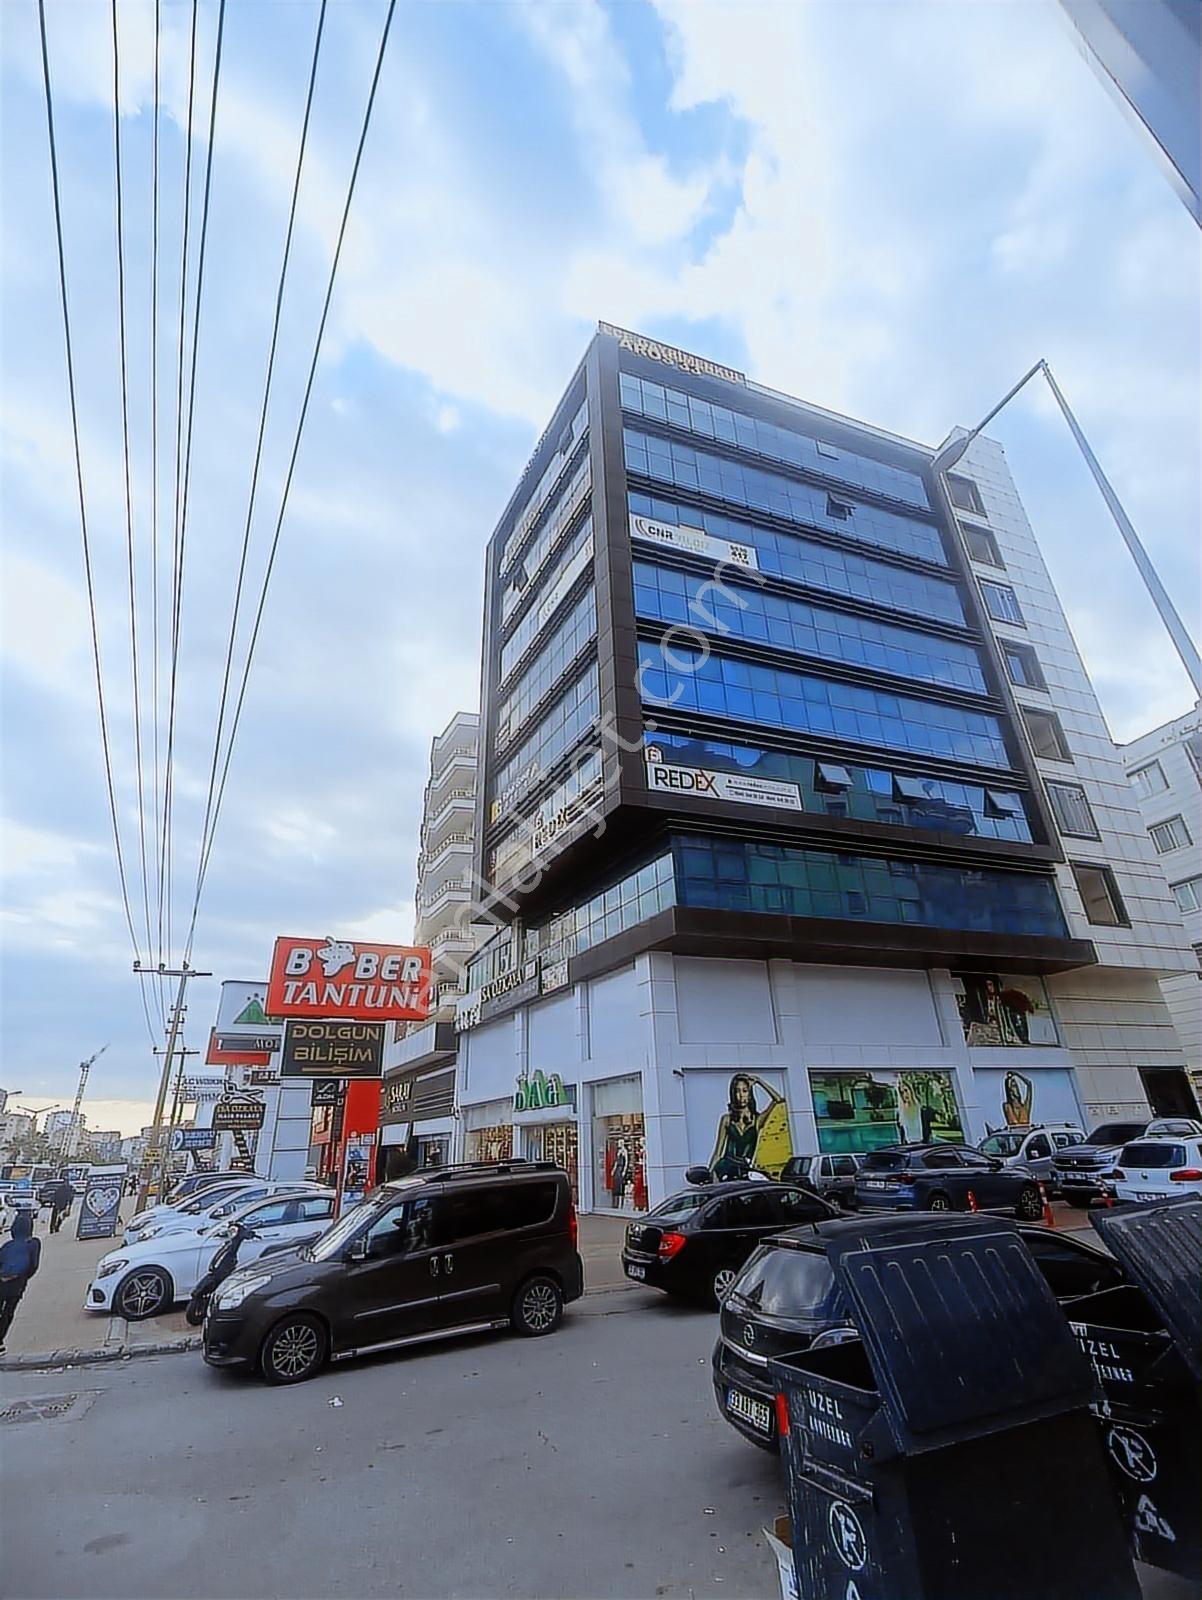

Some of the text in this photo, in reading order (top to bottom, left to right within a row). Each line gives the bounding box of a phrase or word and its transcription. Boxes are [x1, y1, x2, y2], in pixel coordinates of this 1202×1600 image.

[648, 525, 673, 540] CNR
[654, 766, 720, 797] REDEX
[291, 1024, 380, 1041] DOLGUN
[293, 1042, 373, 1065] BİLİŞİM
